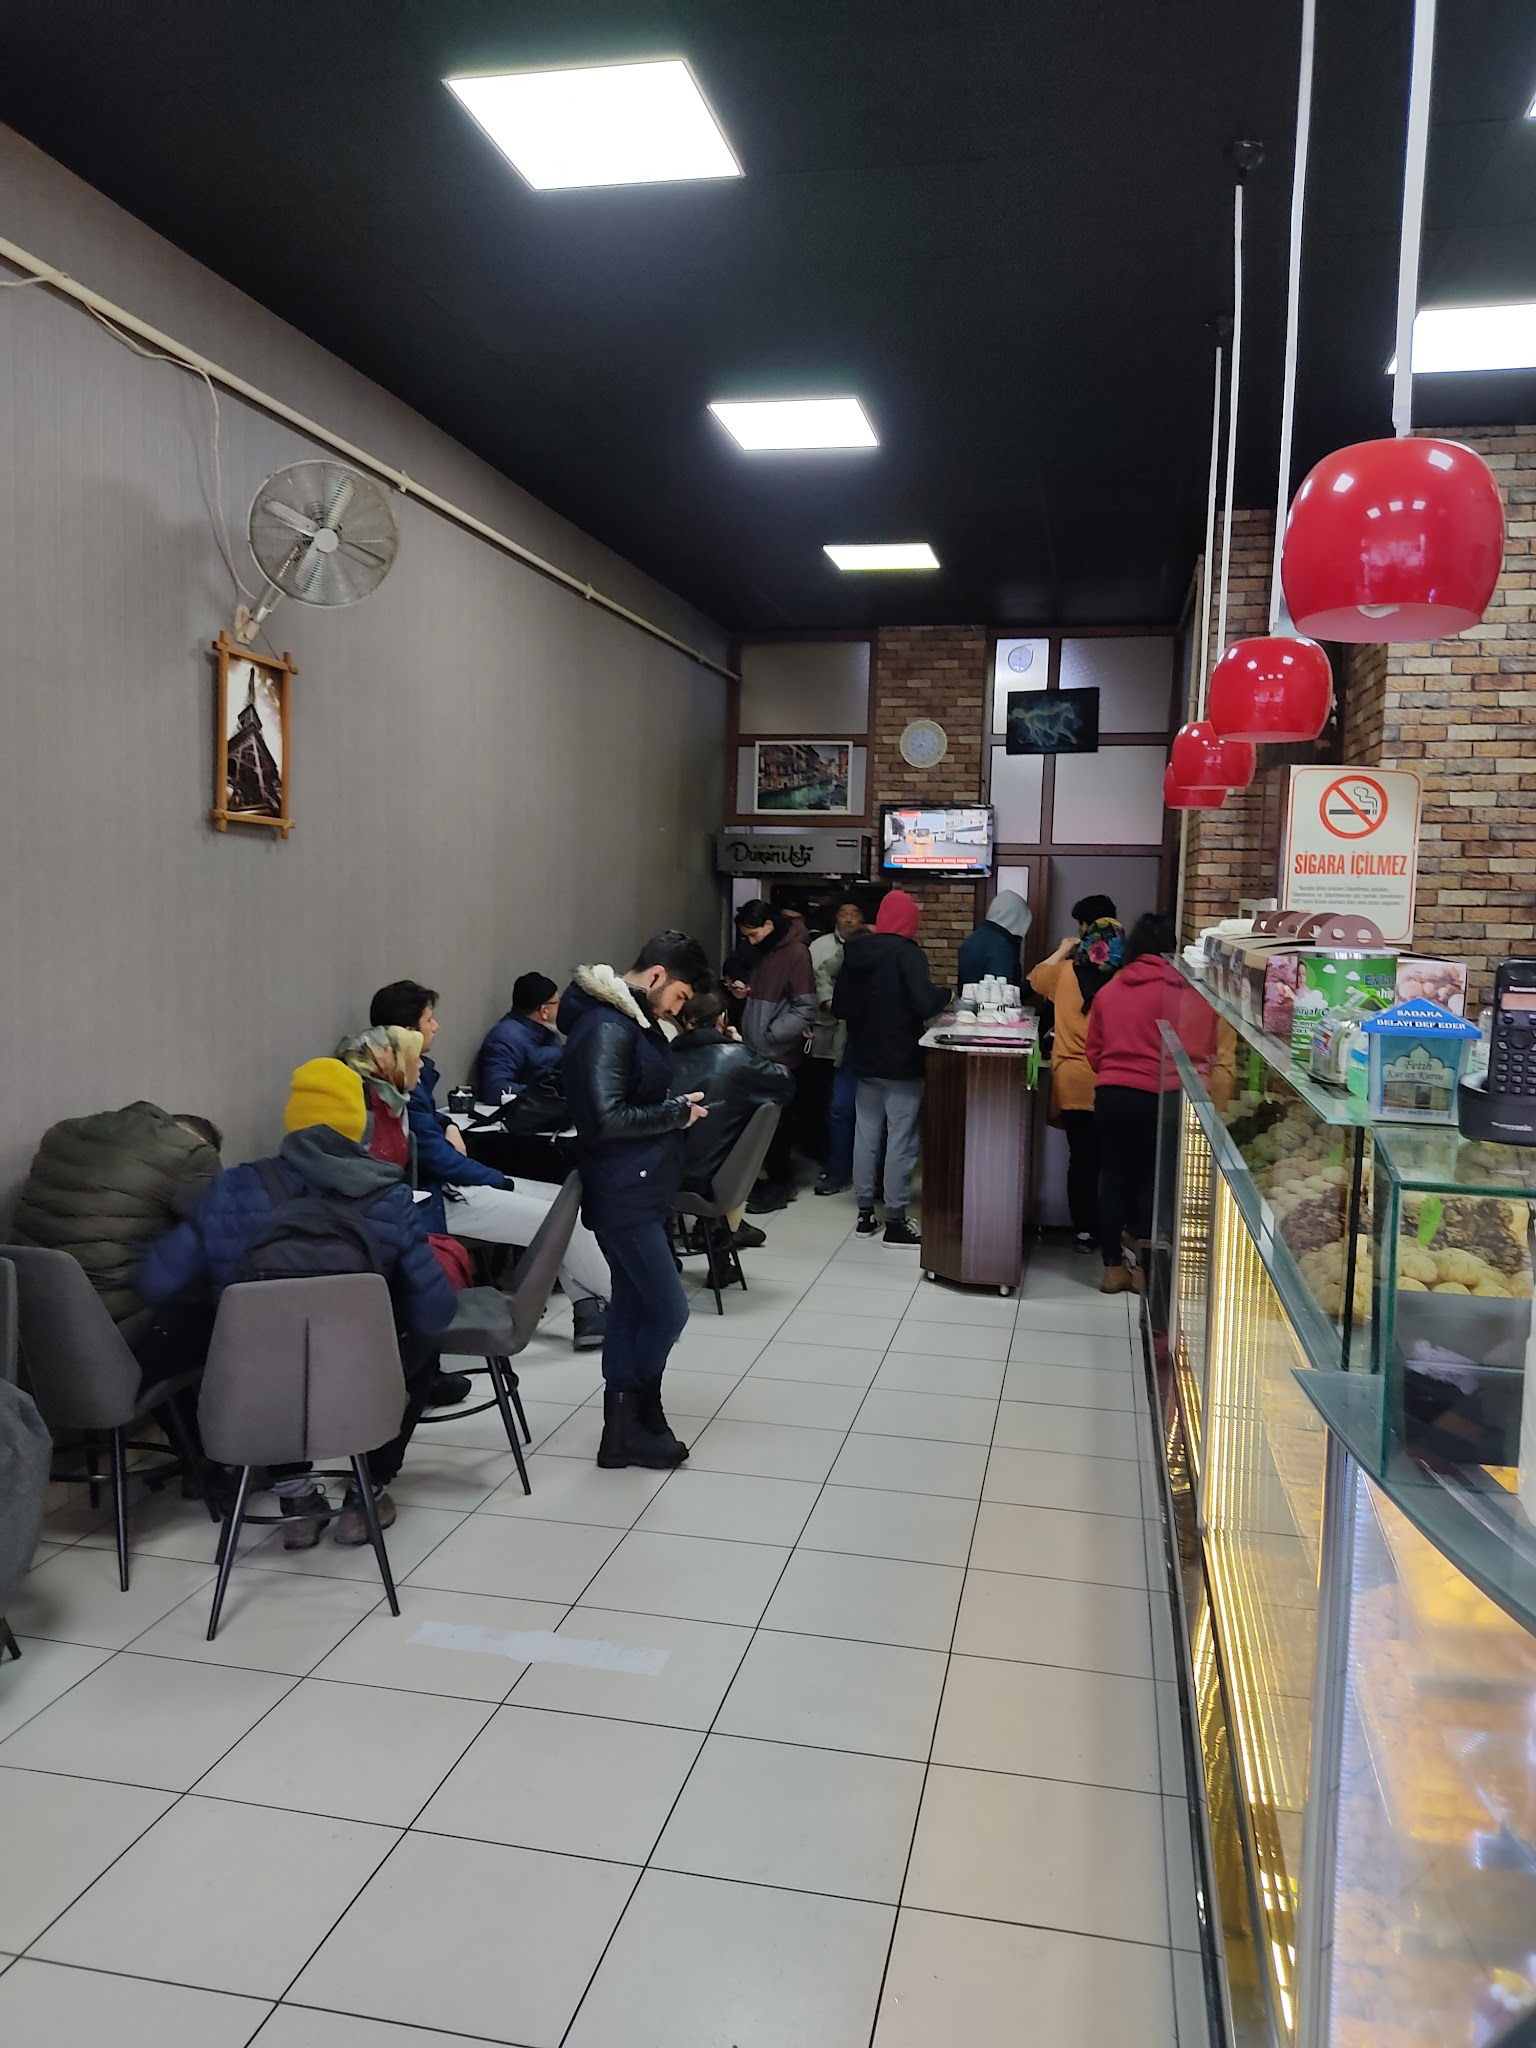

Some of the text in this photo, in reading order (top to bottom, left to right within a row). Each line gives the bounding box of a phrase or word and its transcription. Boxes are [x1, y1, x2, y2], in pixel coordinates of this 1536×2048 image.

[1294, 851, 1408, 878] SİGARA İÇİLMEZ
[1405, 1060, 1432, 1070] Fetih
